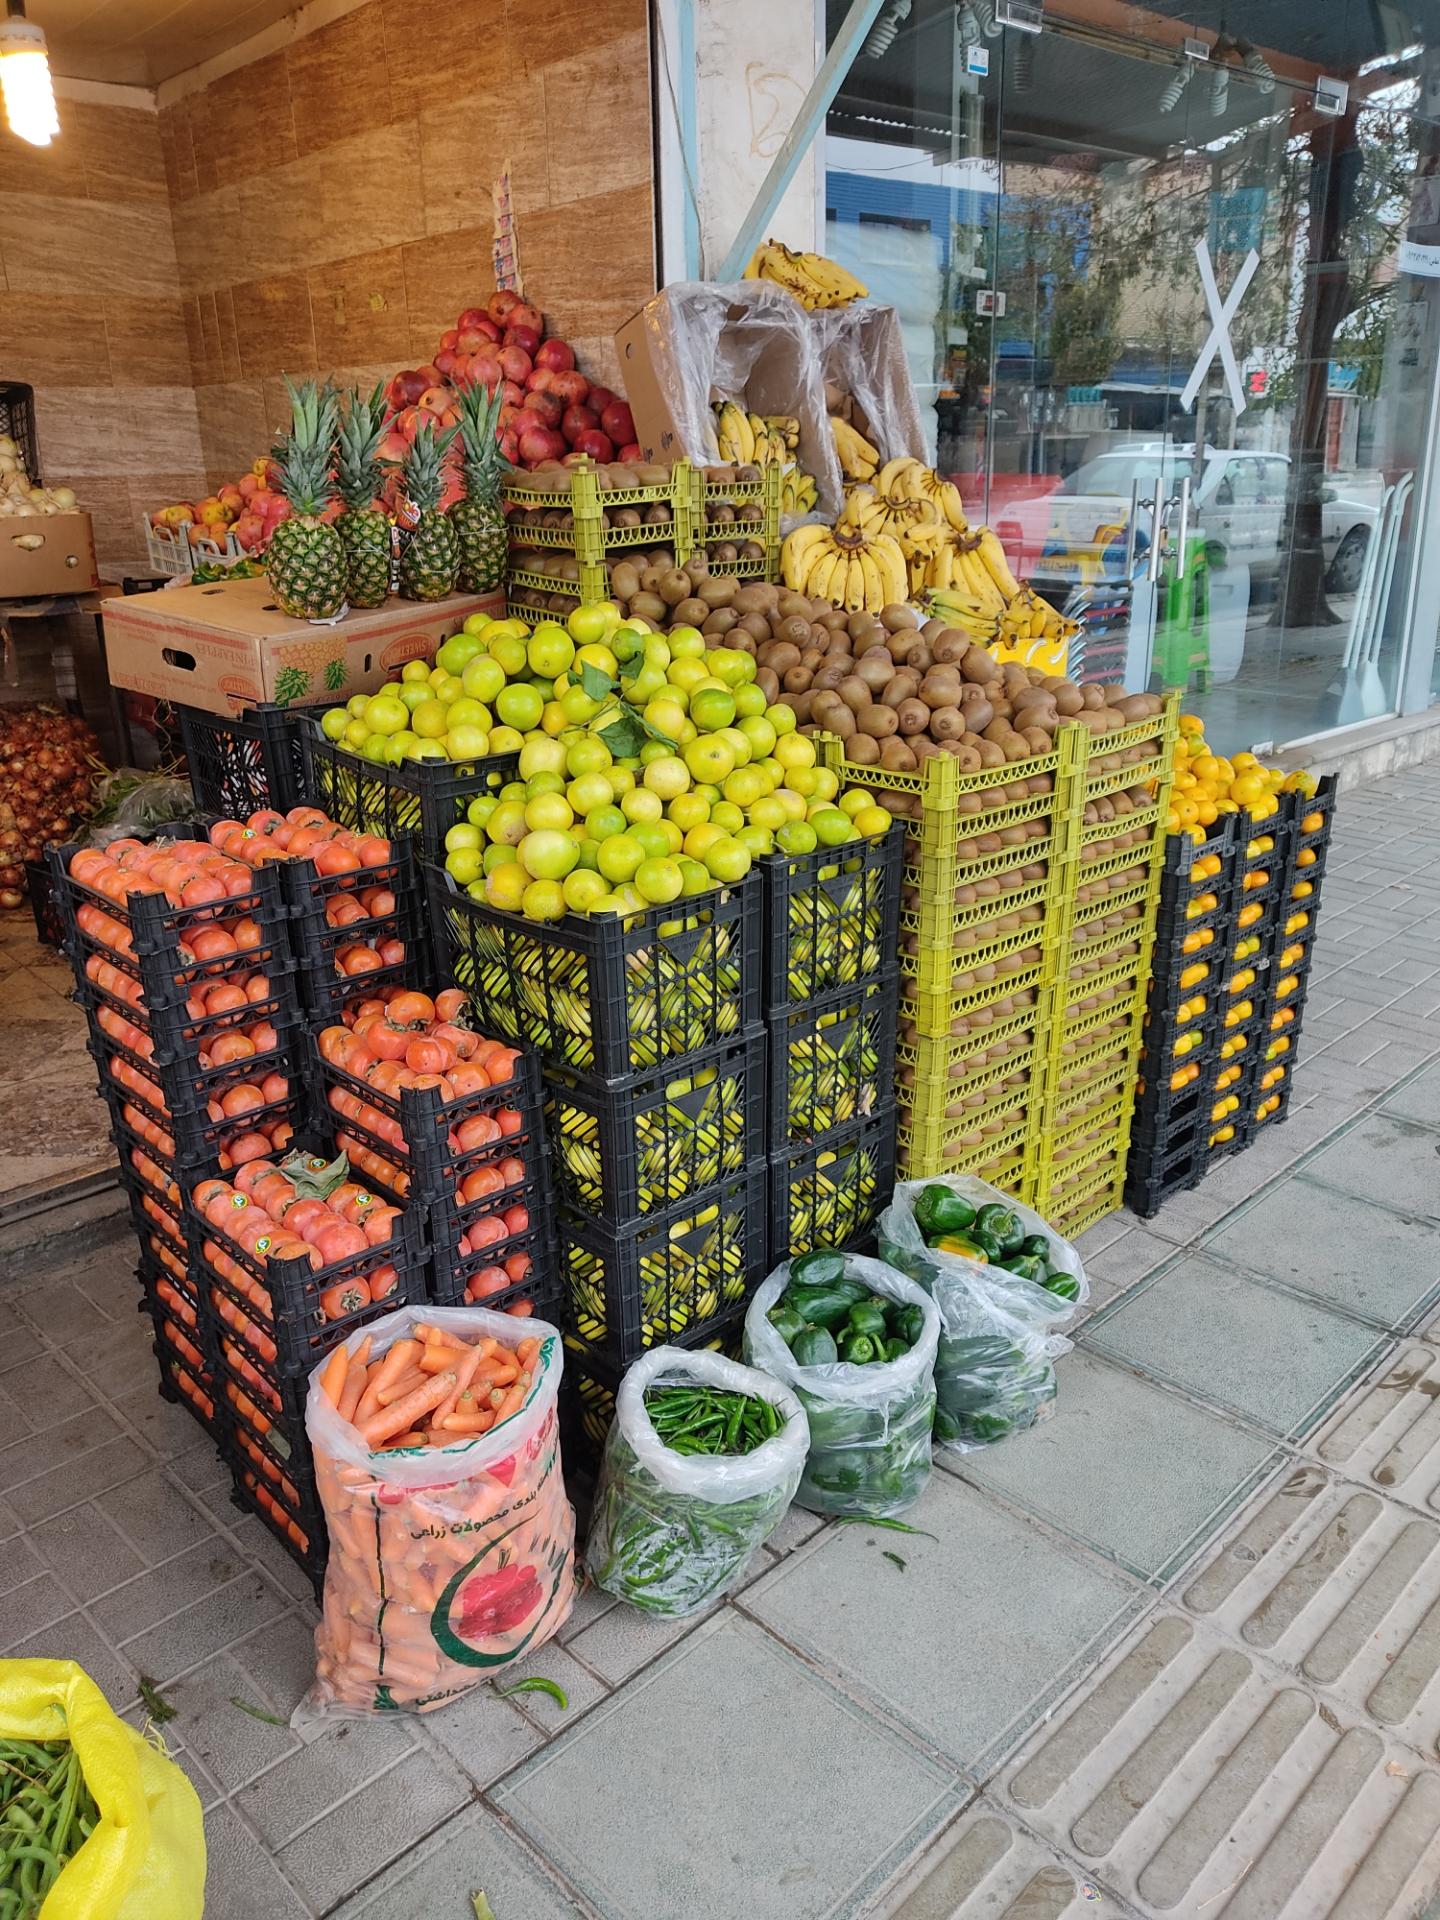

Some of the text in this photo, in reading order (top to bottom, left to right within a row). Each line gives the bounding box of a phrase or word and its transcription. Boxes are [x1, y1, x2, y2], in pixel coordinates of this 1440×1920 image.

[195, 642, 256, 666] PINEAPPLES
[410, 1524, 447, 1540] زراعی
[450, 1508, 510, 1537] محصولات
